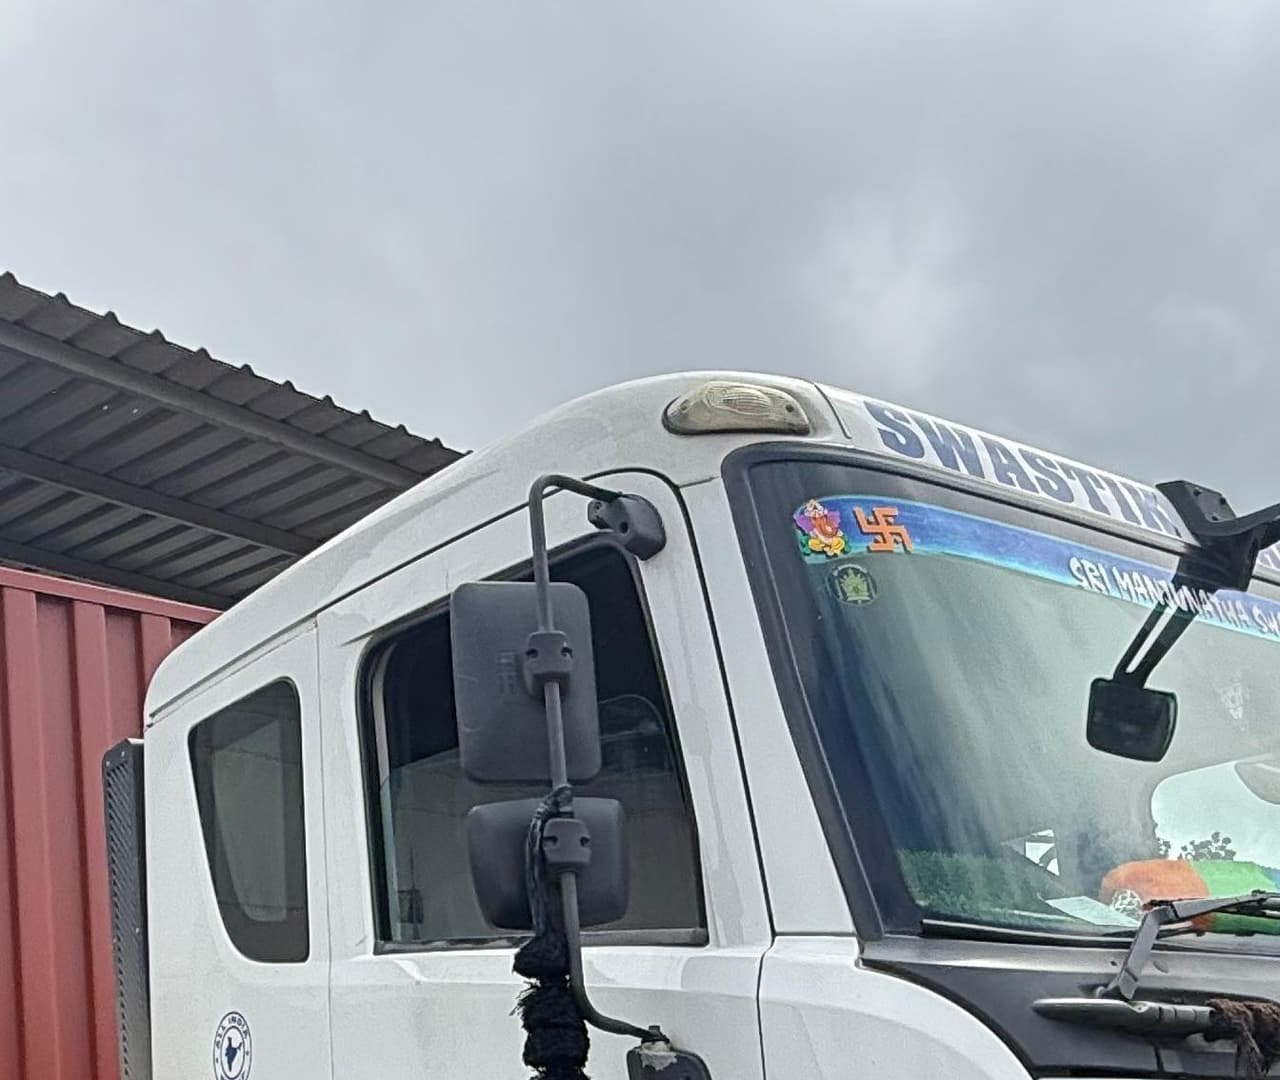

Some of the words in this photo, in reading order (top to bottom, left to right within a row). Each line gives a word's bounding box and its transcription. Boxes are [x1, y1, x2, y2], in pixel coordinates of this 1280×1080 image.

[864, 400, 1182, 538] SWASTIK
[1069, 556, 1114, 594] SRI
[1112, 567, 1249, 628] MANJUNATHA
[228, 1015, 249, 1040] INDIA
